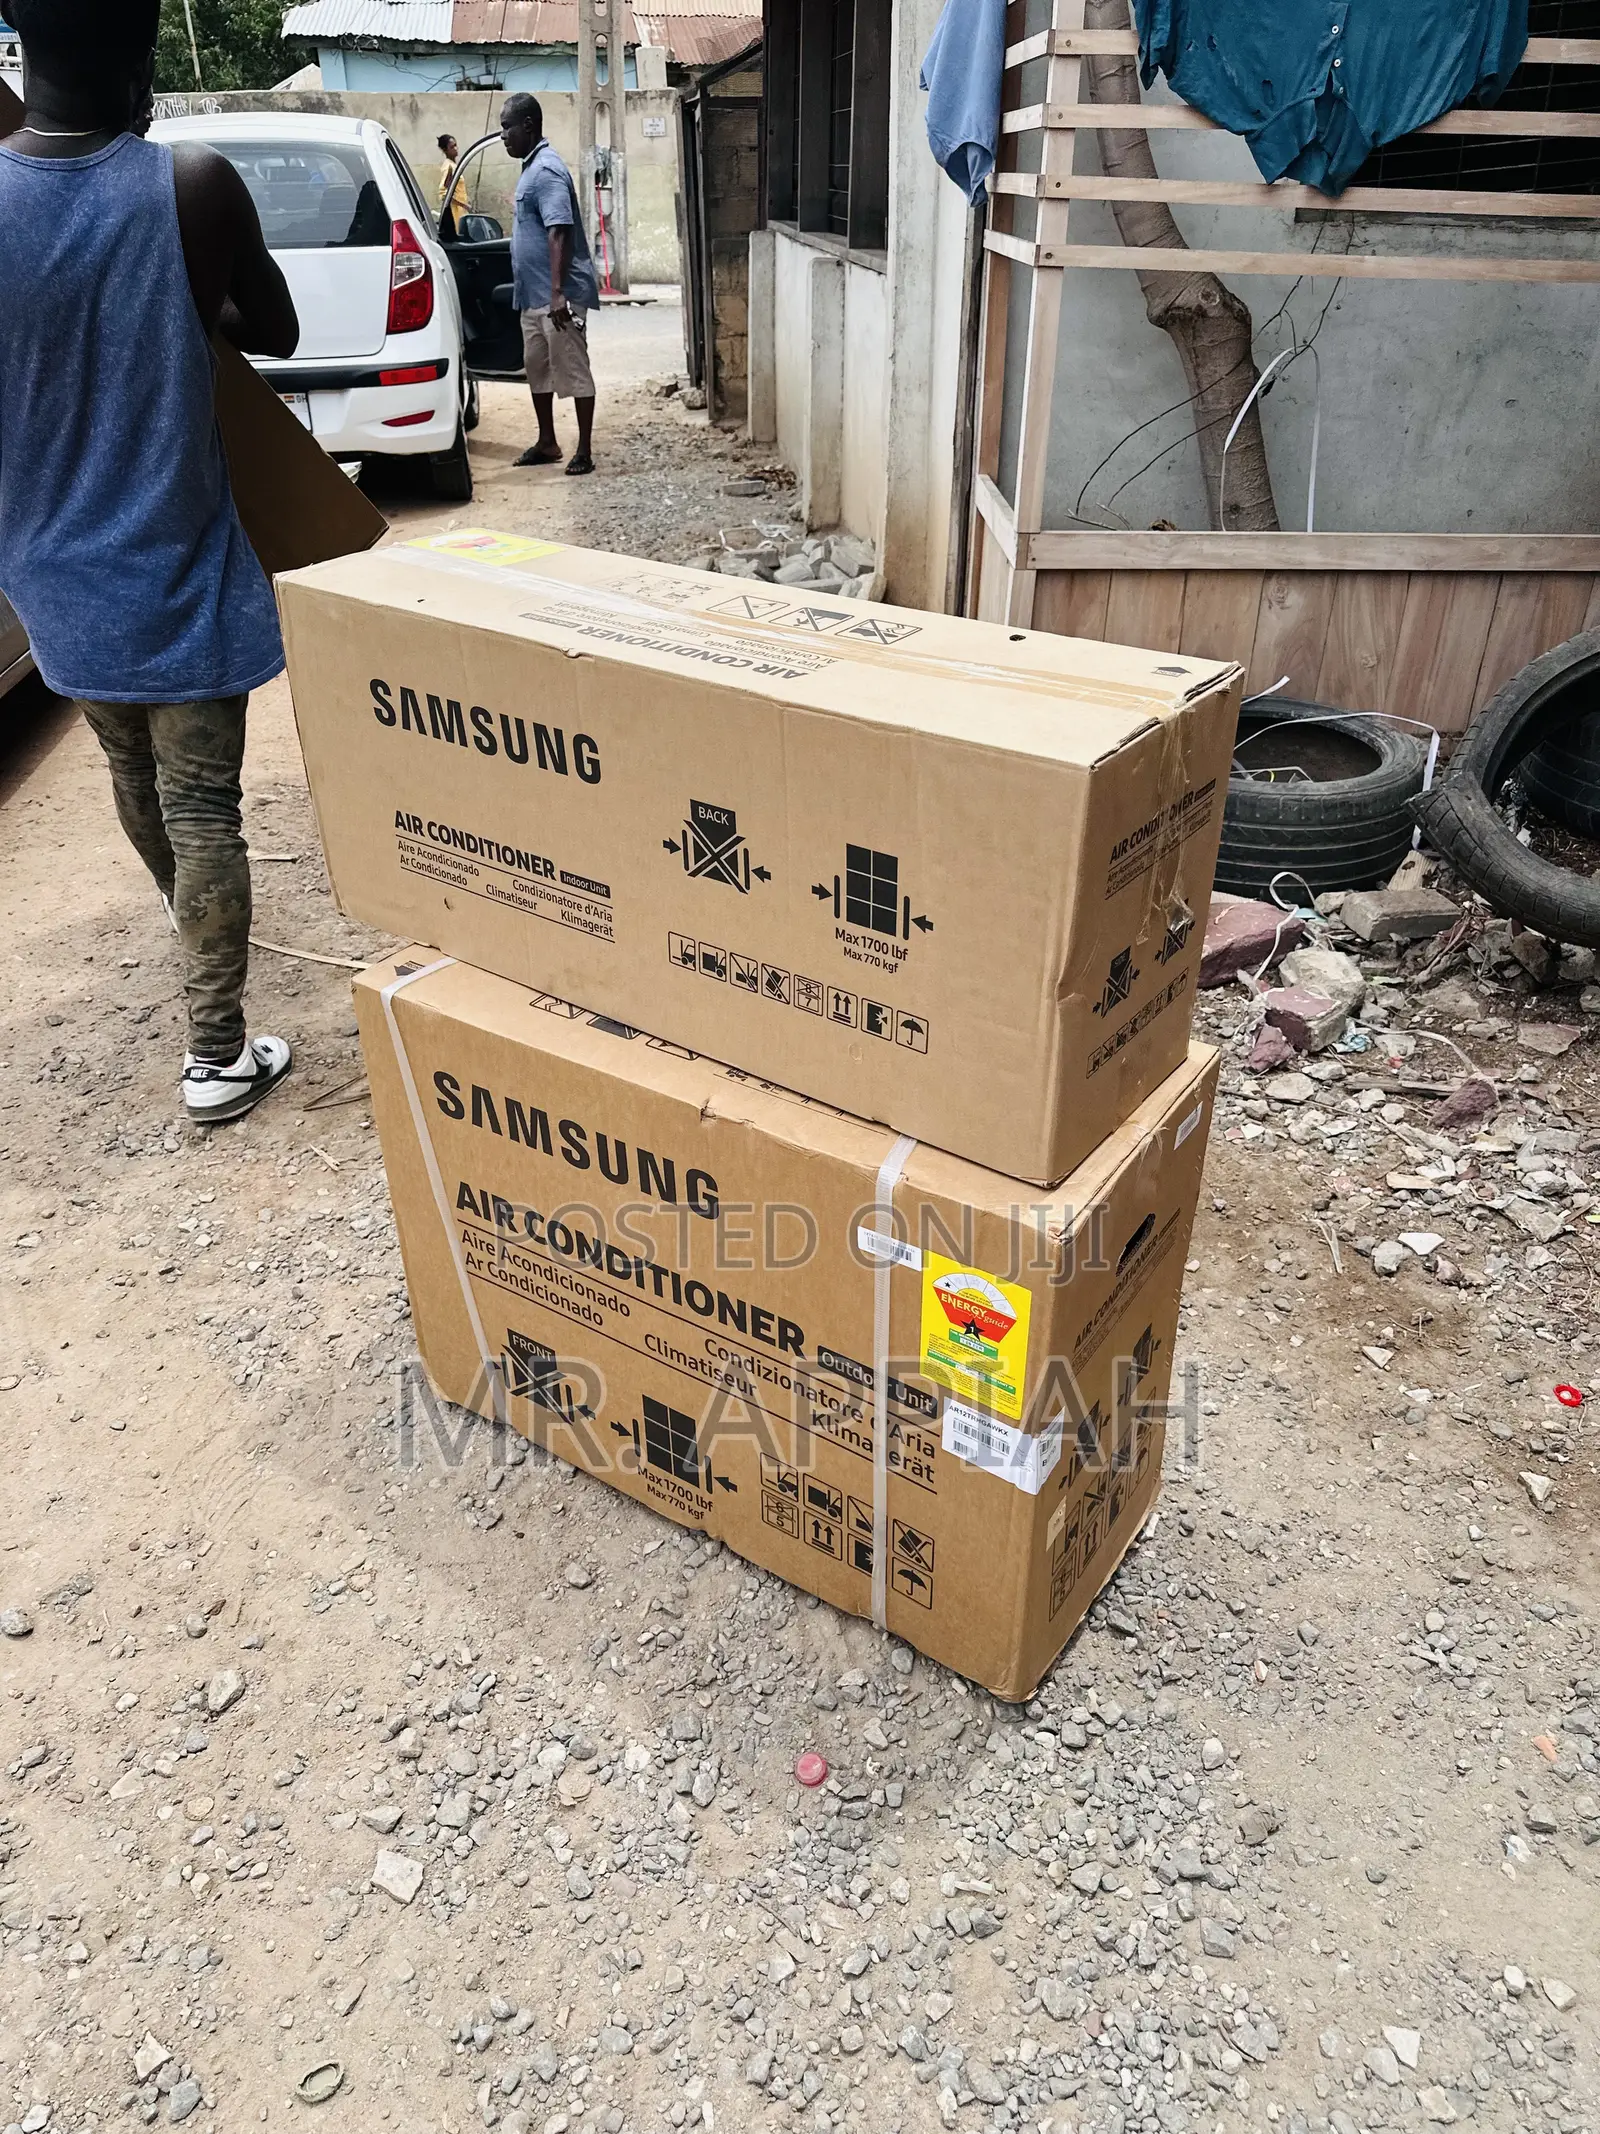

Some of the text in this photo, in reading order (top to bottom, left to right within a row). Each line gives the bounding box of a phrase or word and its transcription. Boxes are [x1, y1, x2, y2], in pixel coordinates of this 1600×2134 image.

[577, 626, 809, 680] AIR CONDITIONER
[705, 640, 829, 670] Aire Acondicionado
[736, 639, 818, 662] Condicionado
[370, 679, 601, 785] SAMSUNG
[698, 806, 729, 826] BACK
[395, 810, 607, 896] AIR CONDITIONER Indoor Unit
[398, 841, 479, 876] Aire Acondicionado
[400, 855, 467, 886] Ar Condicionado
[1109, 838, 1128, 864] AIR
[486, 884, 613, 937] Climatiseur Klimagerät
[513, 880, 612, 922] Condizionatore d'Aria
[835, 927, 908, 961] Max 1700 lbf
[843, 946, 898, 973] Max 770 kgf
[189, 1069, 209, 1078] NIKE
[433, 1070, 720, 1220] SAMSUNG
[462, 1230, 630, 1317] Aire Acondicionado
[466, 1252, 603, 1326] Ar Condicionado
[1074, 1233, 1159, 1350] AIR CONDITIONER
[456, 1181, 518, 1234] AIR
[524, 1211, 808, 1361] CONDITIONER
[822, 1351, 891, 1391] Outdo
[895, 1382, 933, 1414] Unit
[941, 1293, 988, 1318] ENERGY
[983, 1315, 1009, 1330] guide
[512, 1334, 552, 1362] FRONT
[704, 1338, 863, 1424] Condizionatore
[644, 1333, 935, 1484] Climatiseur Klimaerät
[637, 1463, 713, 1512] Max 1700 lbf
[647, 1484, 704, 1520] Max 770 kgf
